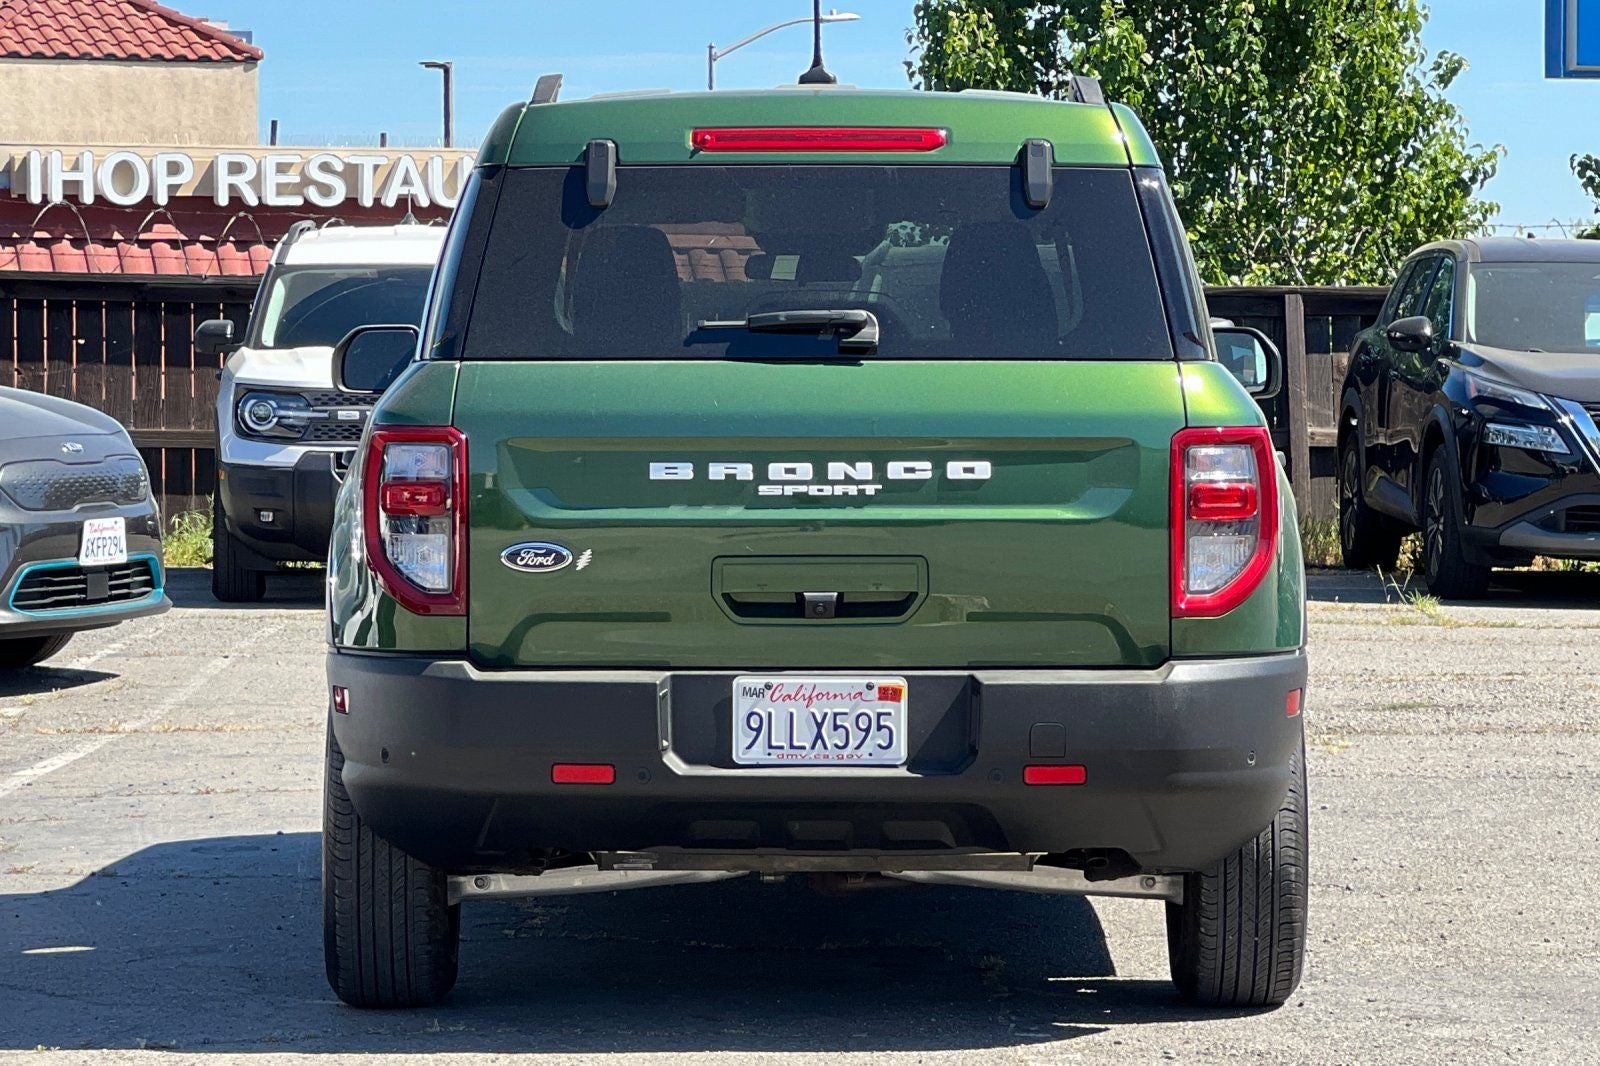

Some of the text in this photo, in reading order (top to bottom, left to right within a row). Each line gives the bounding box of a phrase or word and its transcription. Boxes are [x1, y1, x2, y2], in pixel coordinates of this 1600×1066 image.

[27, 149, 194, 206] IHOP
[648, 460, 992, 481] BRONCO
[757, 484, 883, 496] SPORT
[516, 548, 556, 566] Ford
[742, 686, 766, 699] MAR
[769, 683, 876, 708] California
[744, 710, 895, 751] 9LLX595
[776, 752, 864, 760] dmv.ca.gov
